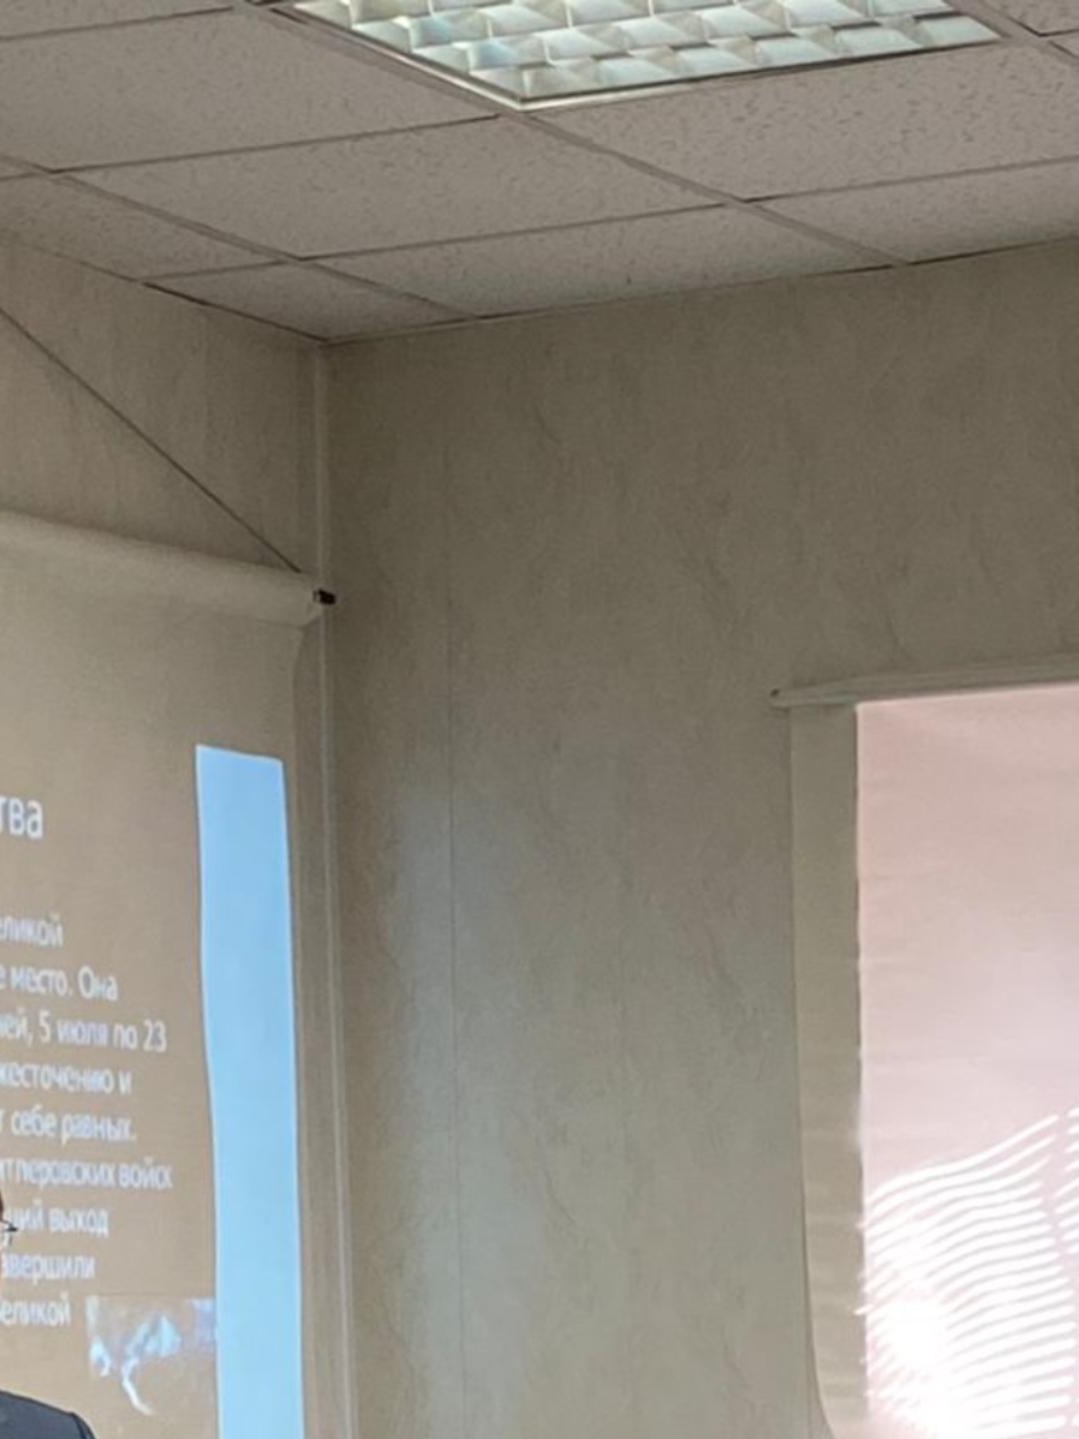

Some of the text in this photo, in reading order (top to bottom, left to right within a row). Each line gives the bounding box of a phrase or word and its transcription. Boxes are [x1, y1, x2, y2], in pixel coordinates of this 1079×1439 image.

[10, 964, 73, 997] место.
[77, 964, 119, 1002] Она
[38, 1009, 52, 1043] 5
[56, 1018, 109, 1047] июля
[112, 1022, 139, 1050] по
[142, 1018, 168, 1053] 23
[118, 1070, 134, 1096] и
[10, 1103, 58, 1138] себе
[61, 1113, 138, 1147] равных.
[119, 1155, 174, 1190] войск
[48, 1206, 110, 1239] выход
